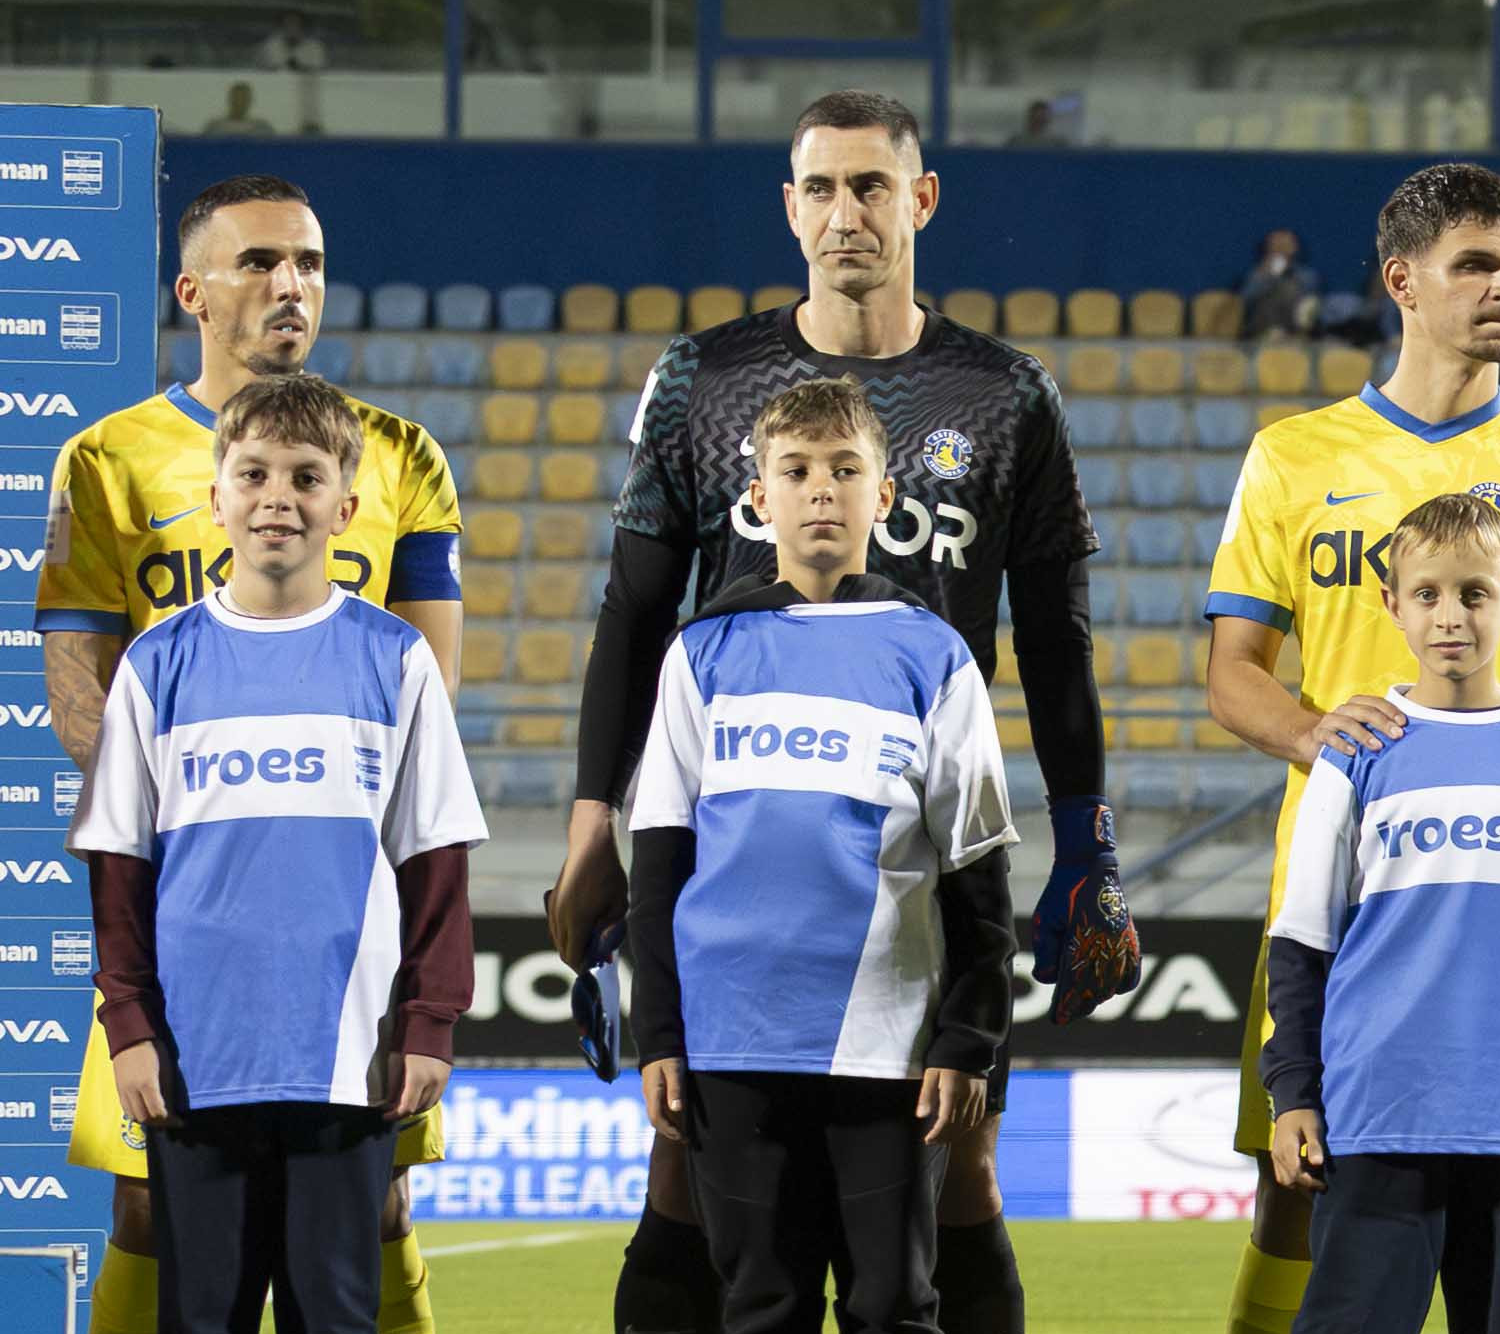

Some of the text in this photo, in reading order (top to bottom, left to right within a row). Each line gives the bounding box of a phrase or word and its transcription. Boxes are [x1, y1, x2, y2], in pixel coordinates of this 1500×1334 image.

[714, 721, 851, 763] iroes
[181, 747, 326, 793] iroes
[408, 1165, 648, 1215] PER LEAG
[1128, 1186, 1258, 1220] TOY
